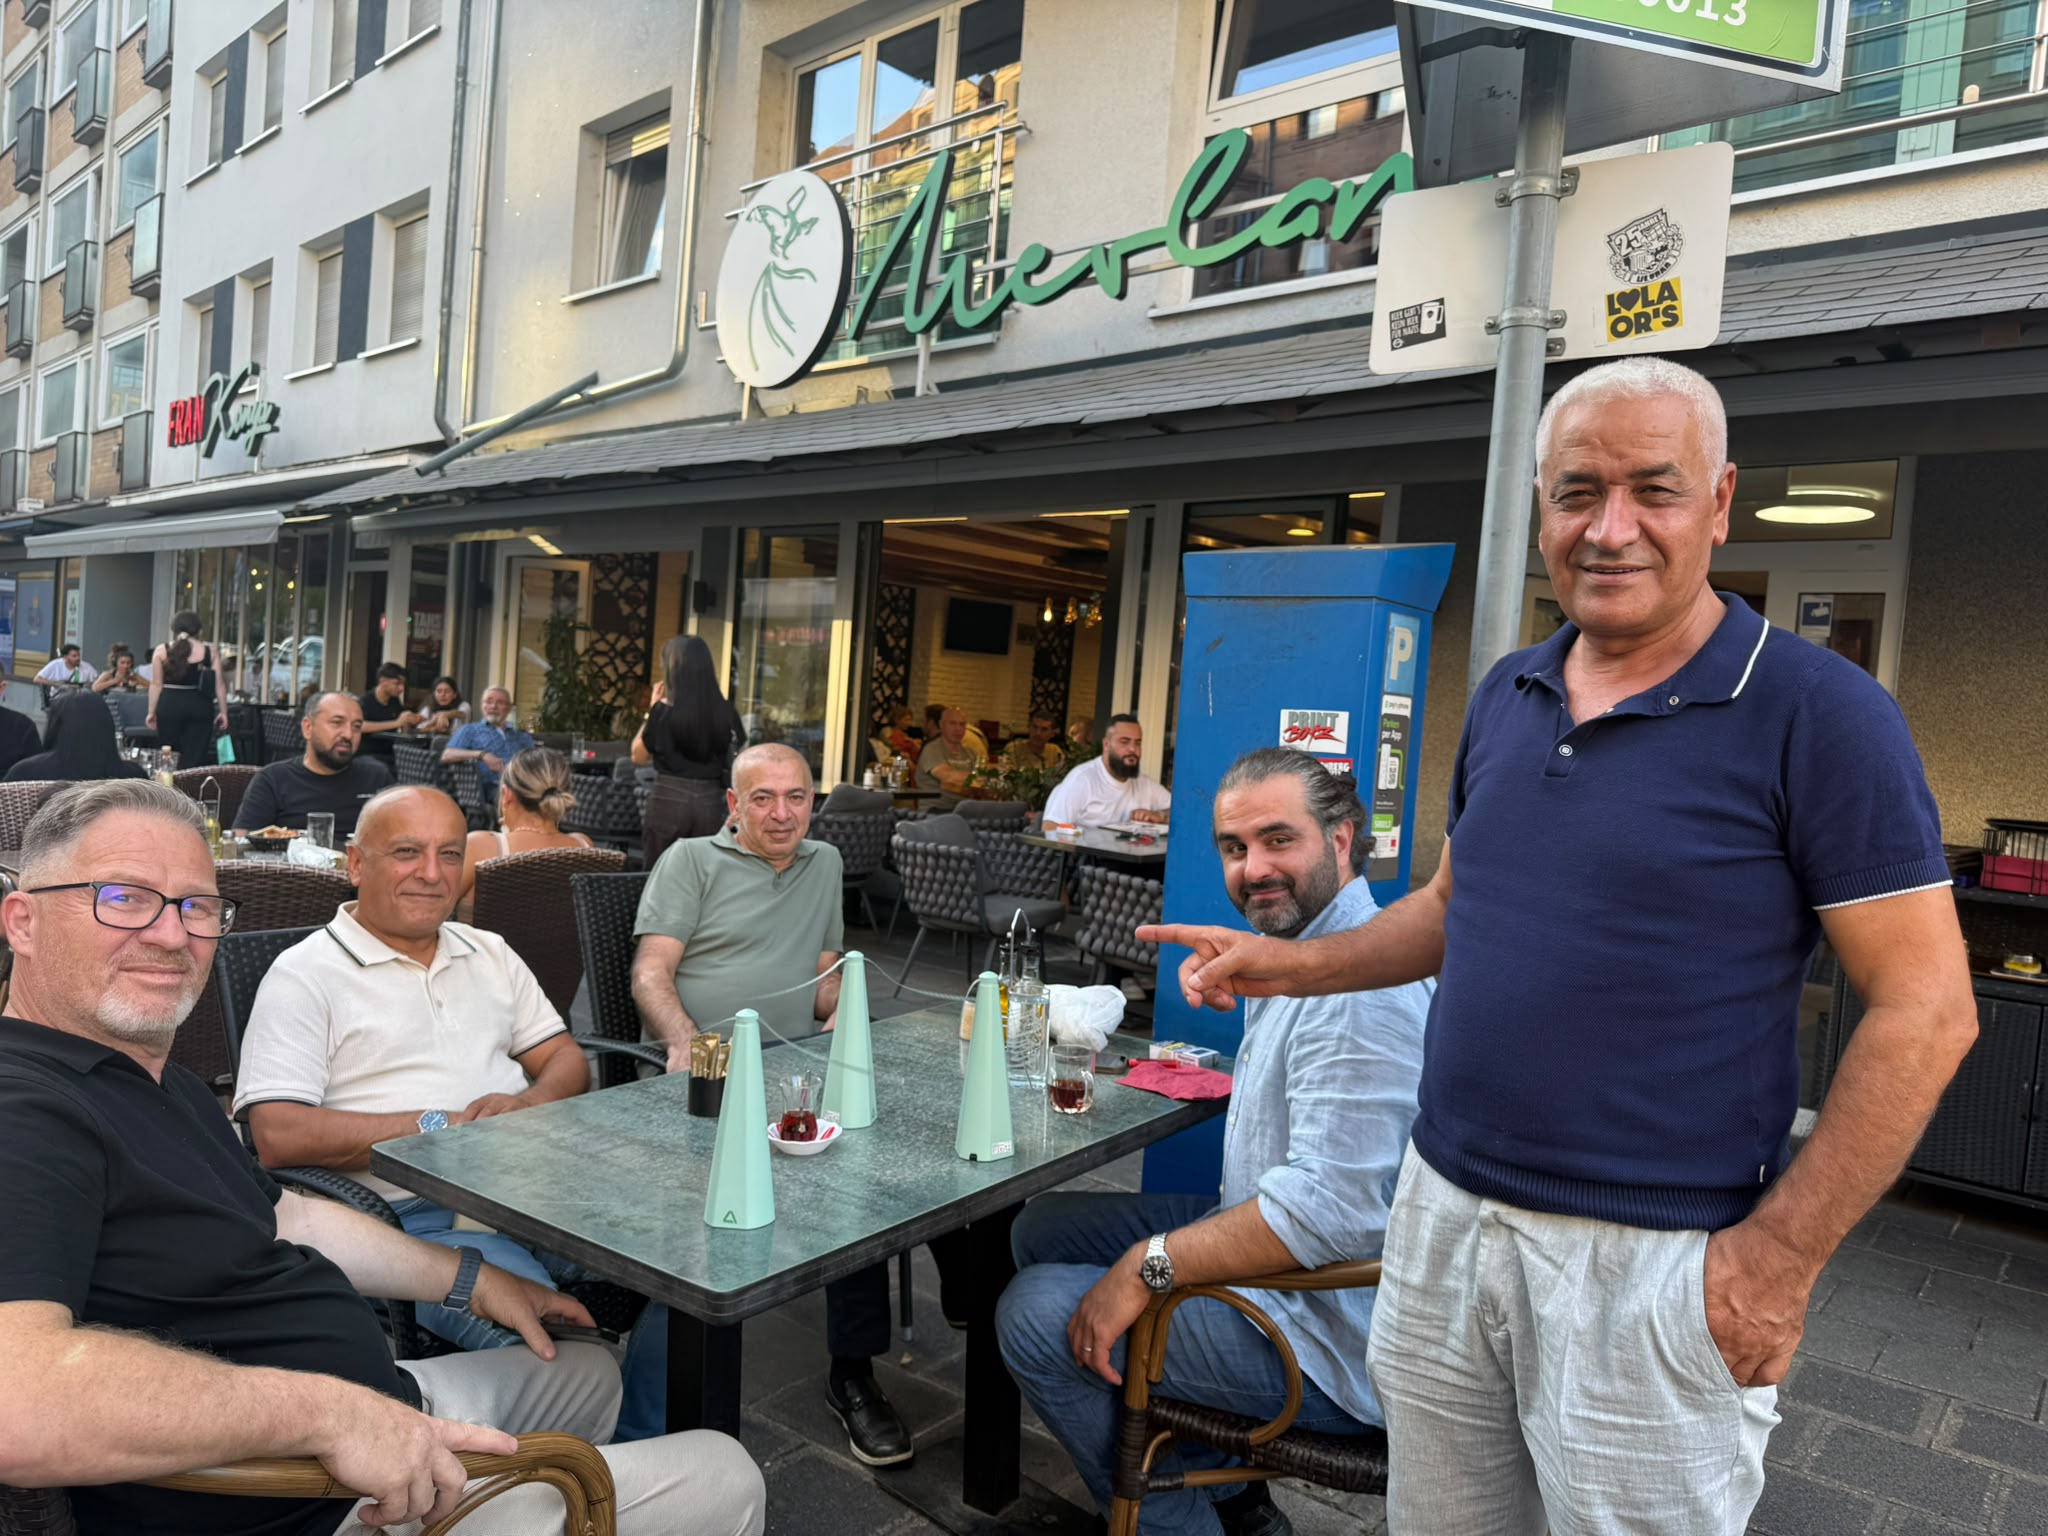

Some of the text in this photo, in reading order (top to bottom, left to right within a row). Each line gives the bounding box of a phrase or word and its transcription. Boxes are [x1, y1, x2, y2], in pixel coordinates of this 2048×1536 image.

[1615, 225, 1642, 257] 25
[1610, 304, 1680, 338] OR'S
[1390, 626, 1413, 681] P
[1287, 711, 1340, 732] PRINT
